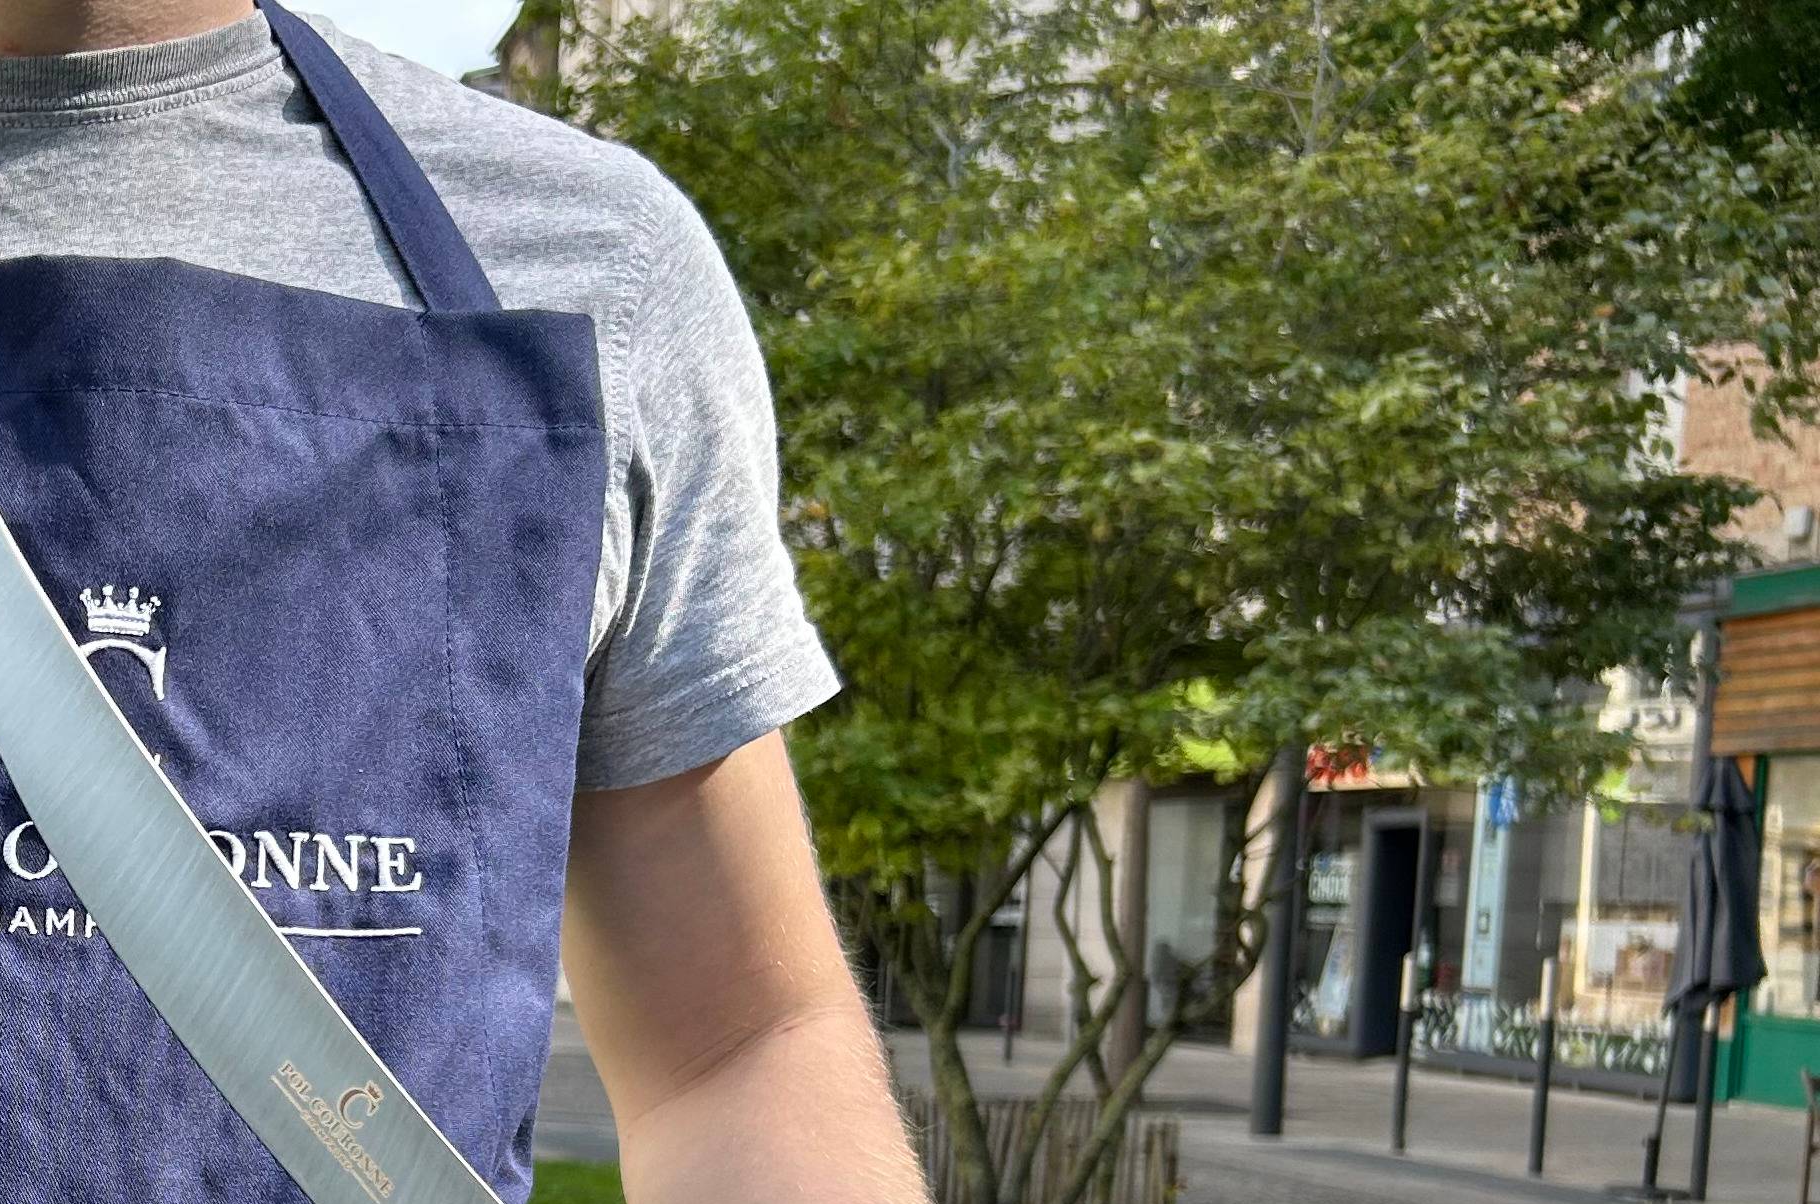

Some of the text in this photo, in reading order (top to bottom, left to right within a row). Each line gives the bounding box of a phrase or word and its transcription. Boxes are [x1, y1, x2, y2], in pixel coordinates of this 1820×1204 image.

[278, 1060, 395, 1199] POL COURONNE
[337, 1086, 380, 1130] C
